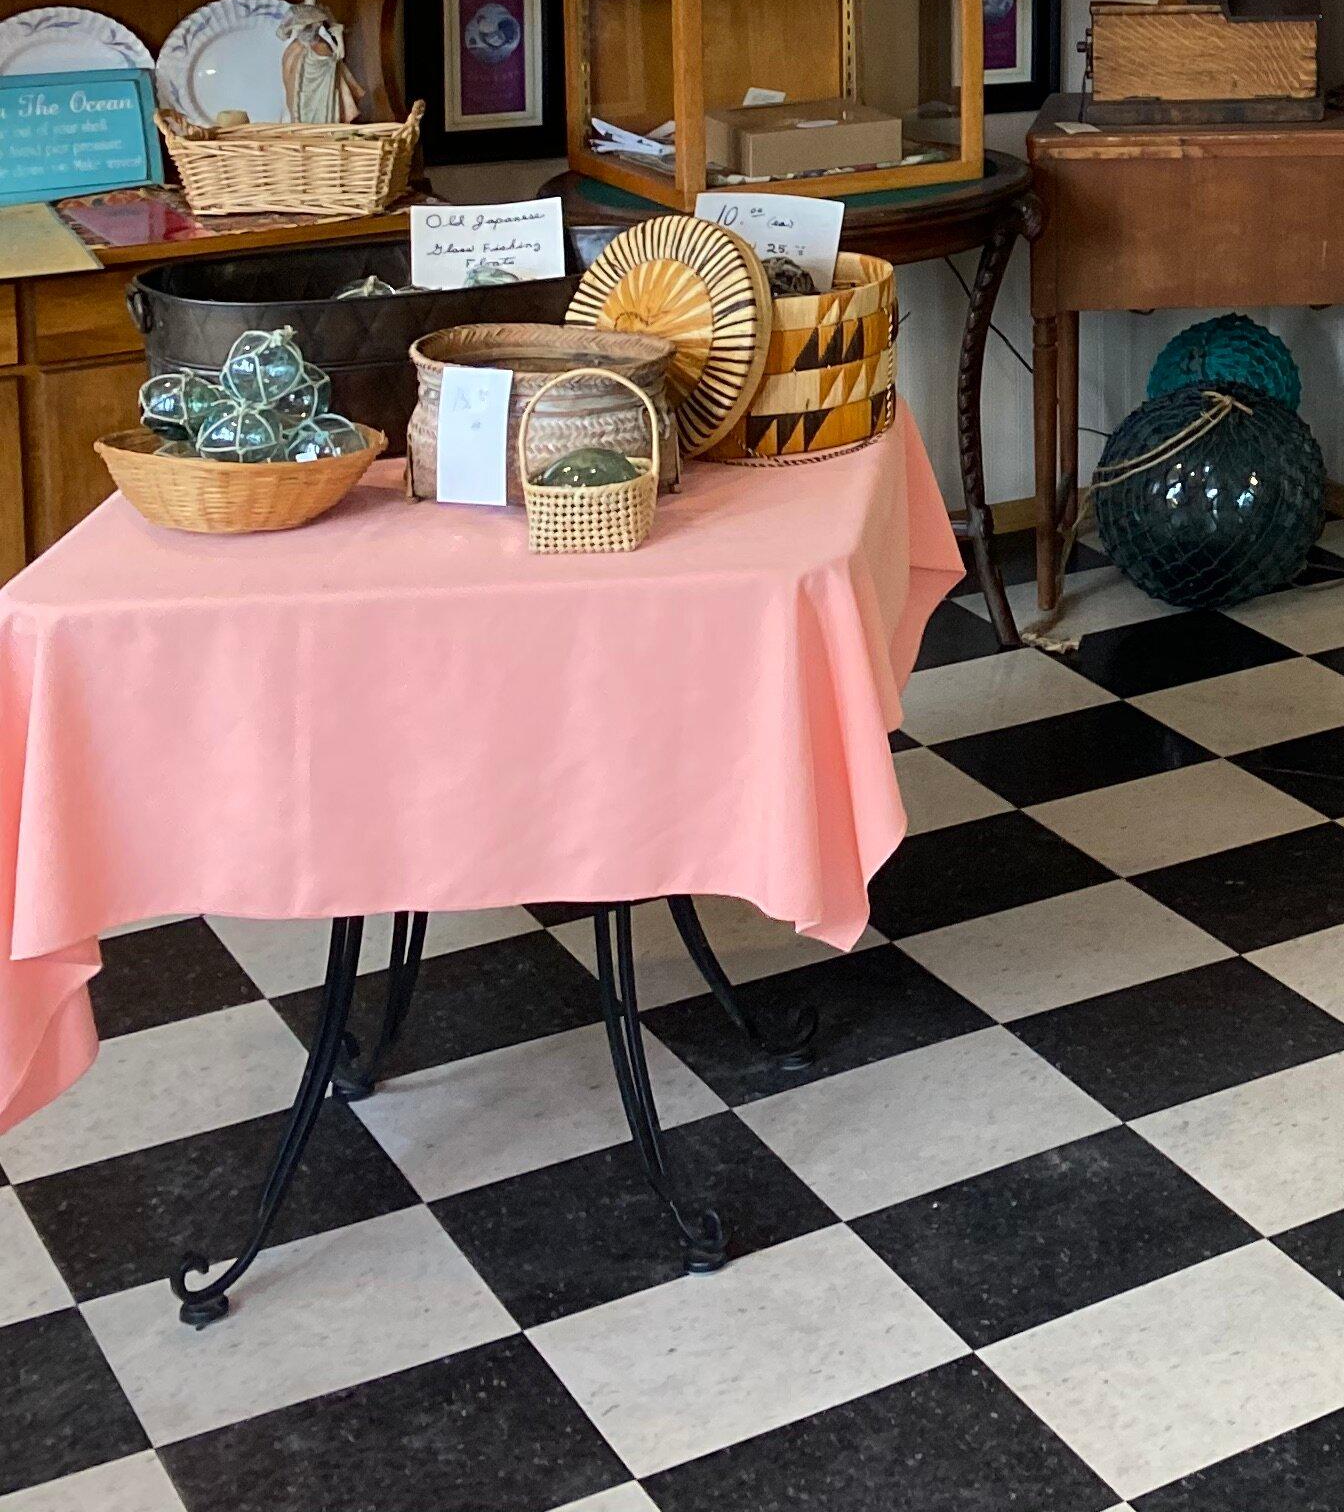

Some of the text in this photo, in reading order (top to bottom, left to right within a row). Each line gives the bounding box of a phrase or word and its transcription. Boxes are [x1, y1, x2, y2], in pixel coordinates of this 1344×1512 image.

[18, 90, 60, 119] The
[69, 88, 135, 115] Ocean
[426, 212, 546, 232] Old Japanese
[483, 238, 542, 253] Fishing
[464, 256, 517, 269] Floats
